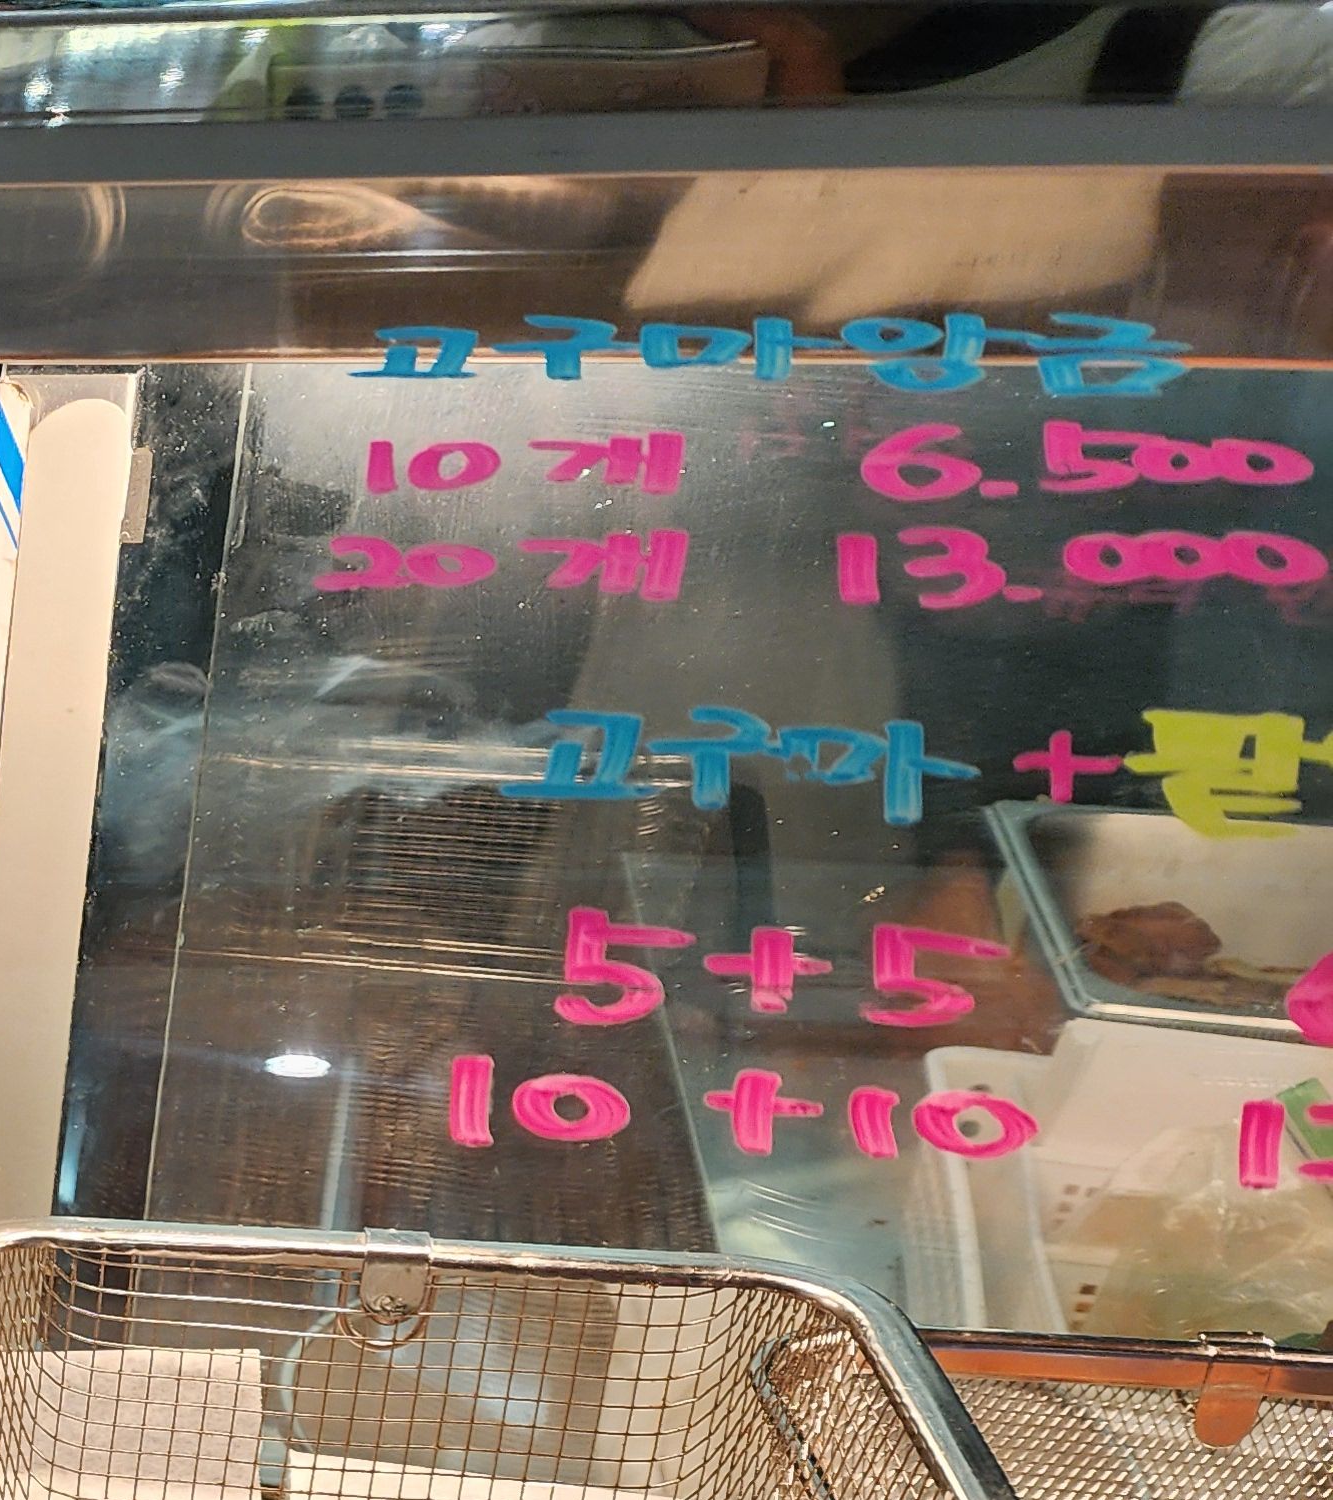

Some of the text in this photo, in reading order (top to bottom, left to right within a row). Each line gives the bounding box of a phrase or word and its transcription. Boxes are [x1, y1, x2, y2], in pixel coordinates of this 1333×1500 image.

[348, 312, 1190, 398] 고구마앙금
[858, 418, 1314, 504] 6.500
[835, 525, 1331, 609] 13.000
[500, 706, 975, 826] 고구마
[1123, 708, 1333, 844] 팥
